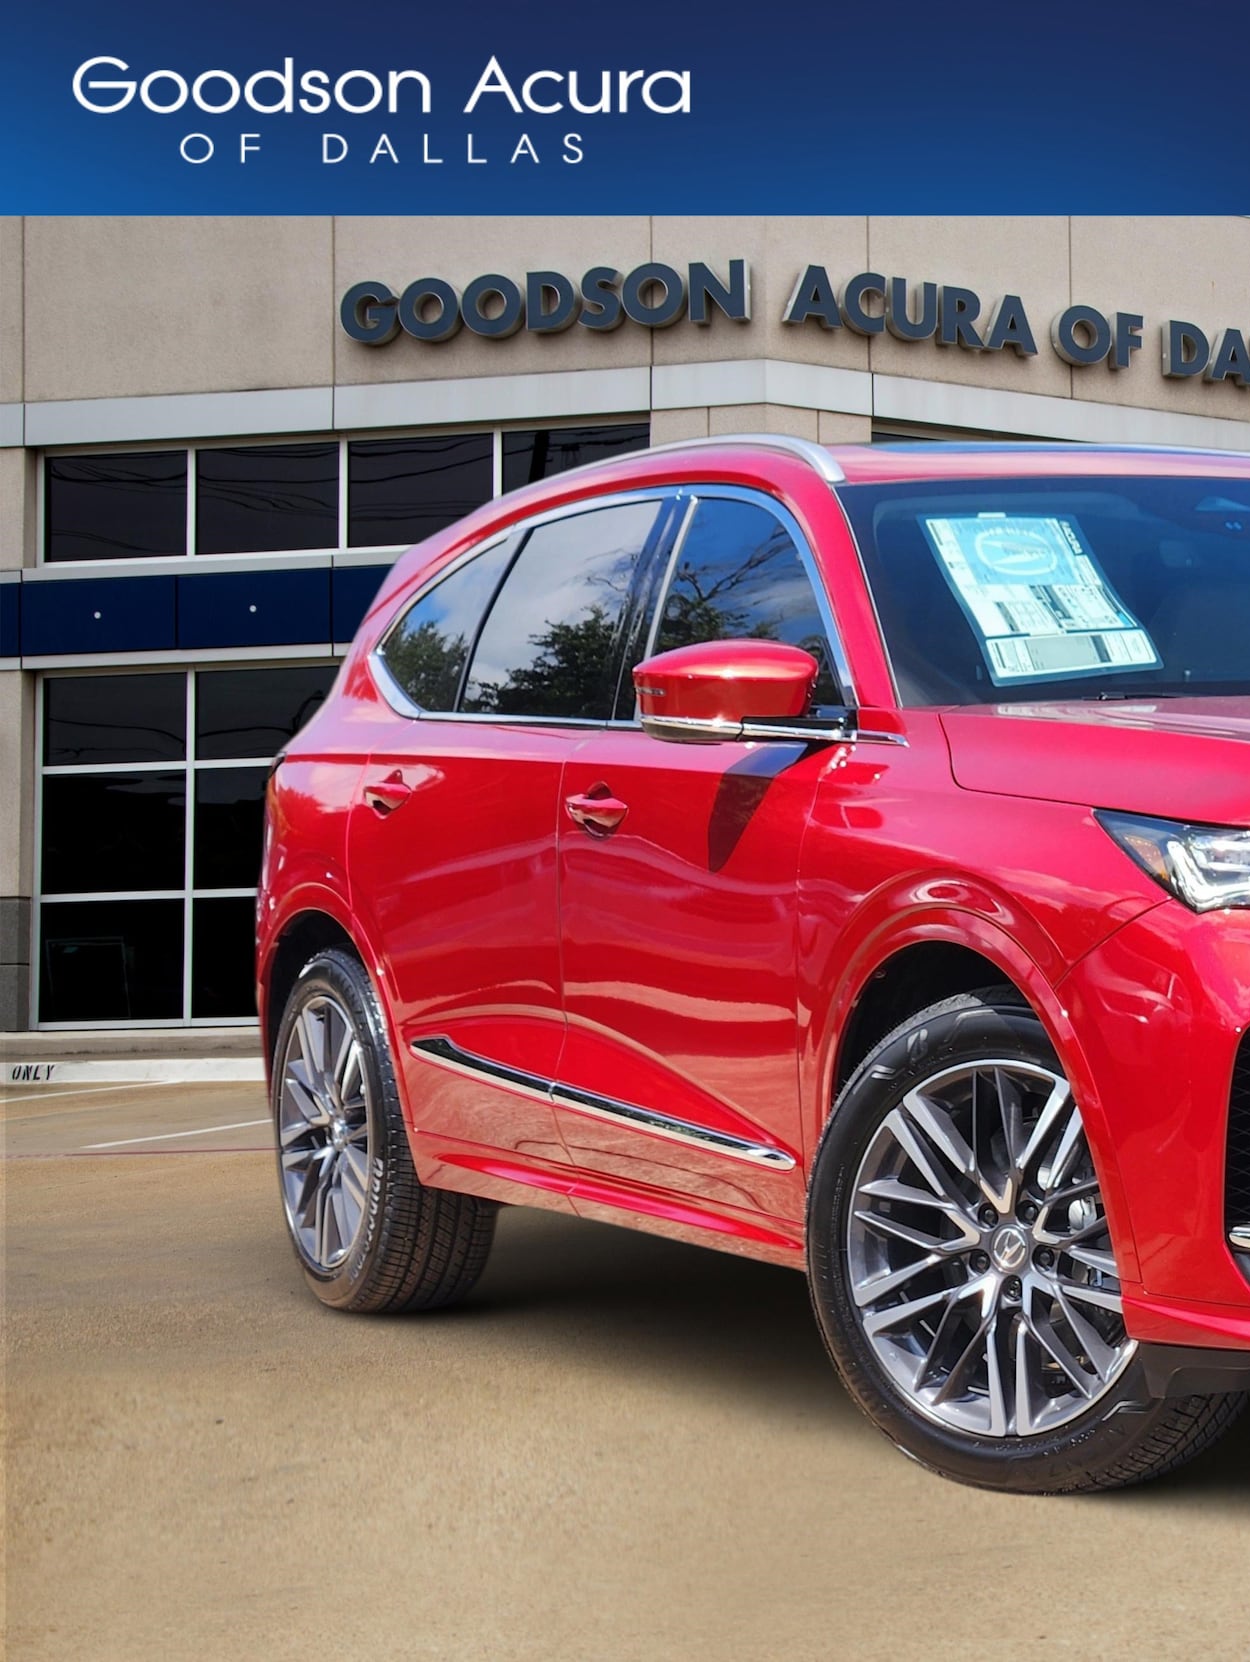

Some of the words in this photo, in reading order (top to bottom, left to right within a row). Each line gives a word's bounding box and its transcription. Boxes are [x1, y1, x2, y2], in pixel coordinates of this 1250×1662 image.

[340, 259, 751, 346] GOODSON
[782, 264, 1038, 357] ACURA
[1050, 304, 1143, 369] OF
[12, 1064, 55, 1081] ONLY
